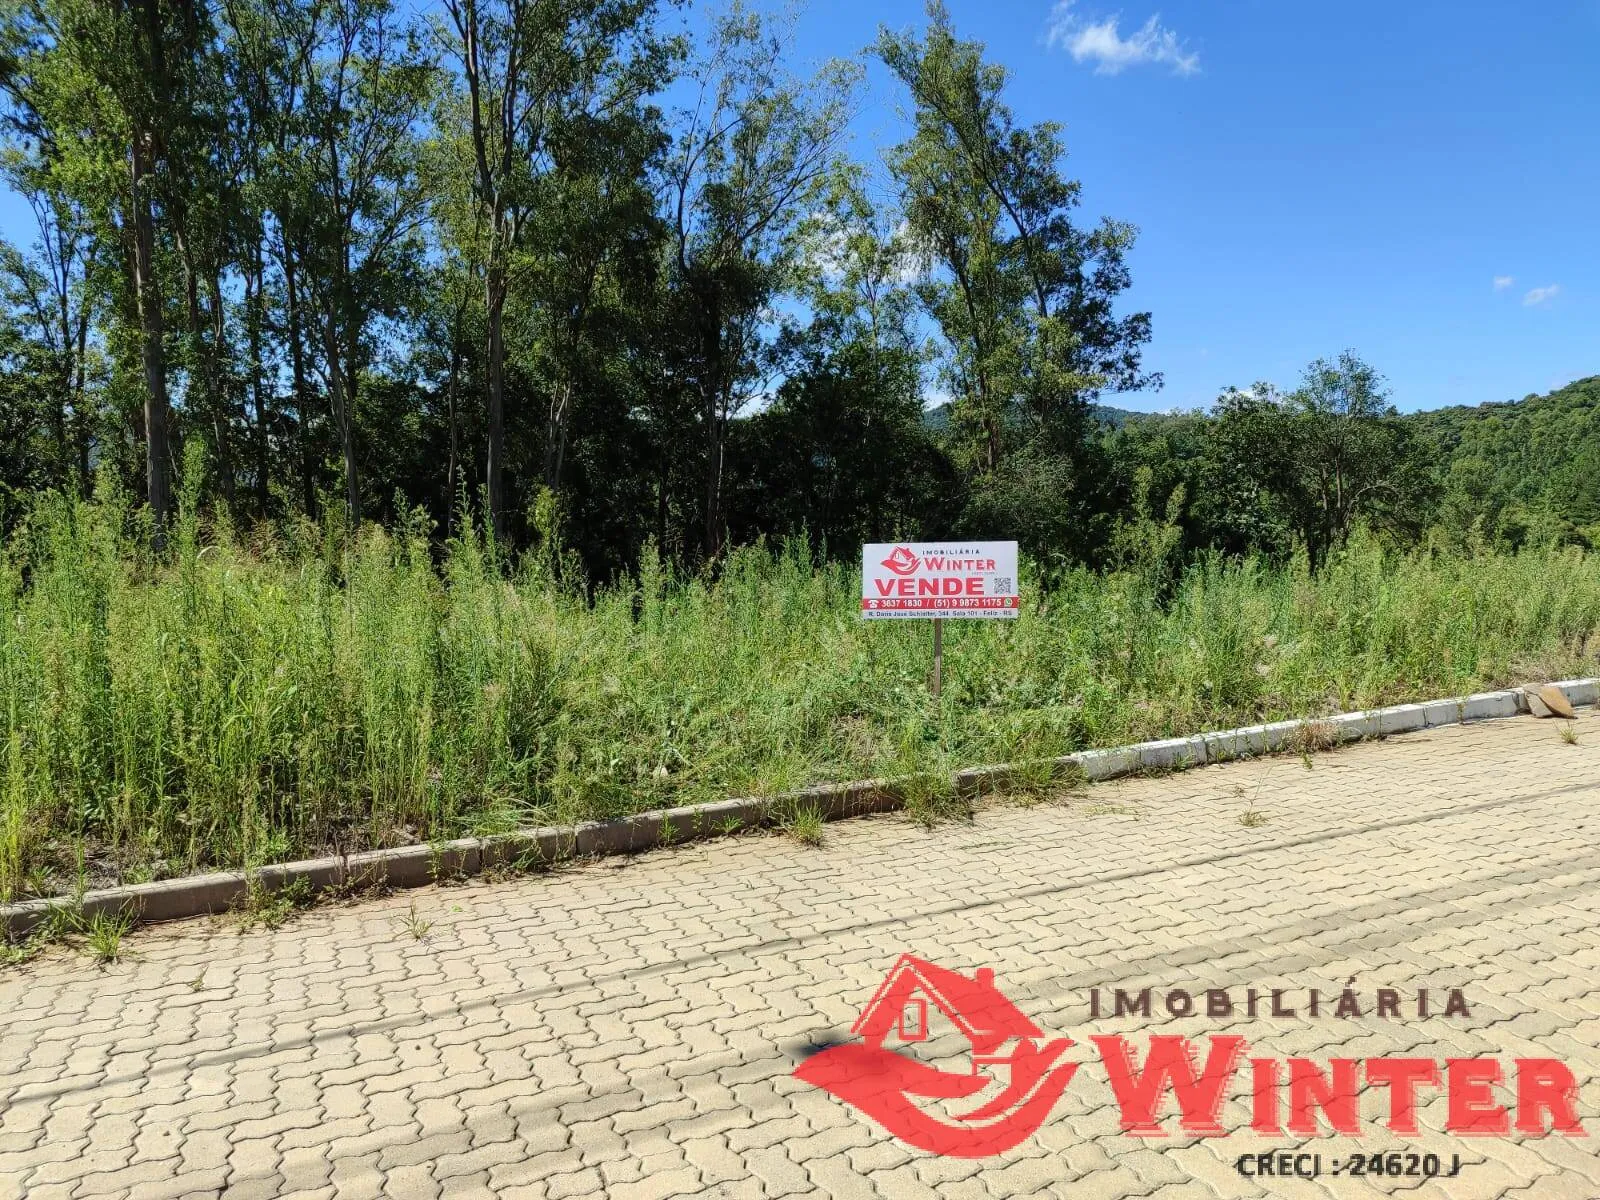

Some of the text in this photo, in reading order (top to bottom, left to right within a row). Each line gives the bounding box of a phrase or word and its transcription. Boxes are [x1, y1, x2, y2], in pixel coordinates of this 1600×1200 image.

[874, 578, 985, 596] VENDE
[903, 599, 922, 607] 1830
[934, 598, 950, 609] (51)
[982, 598, 1002, 607] 1175
